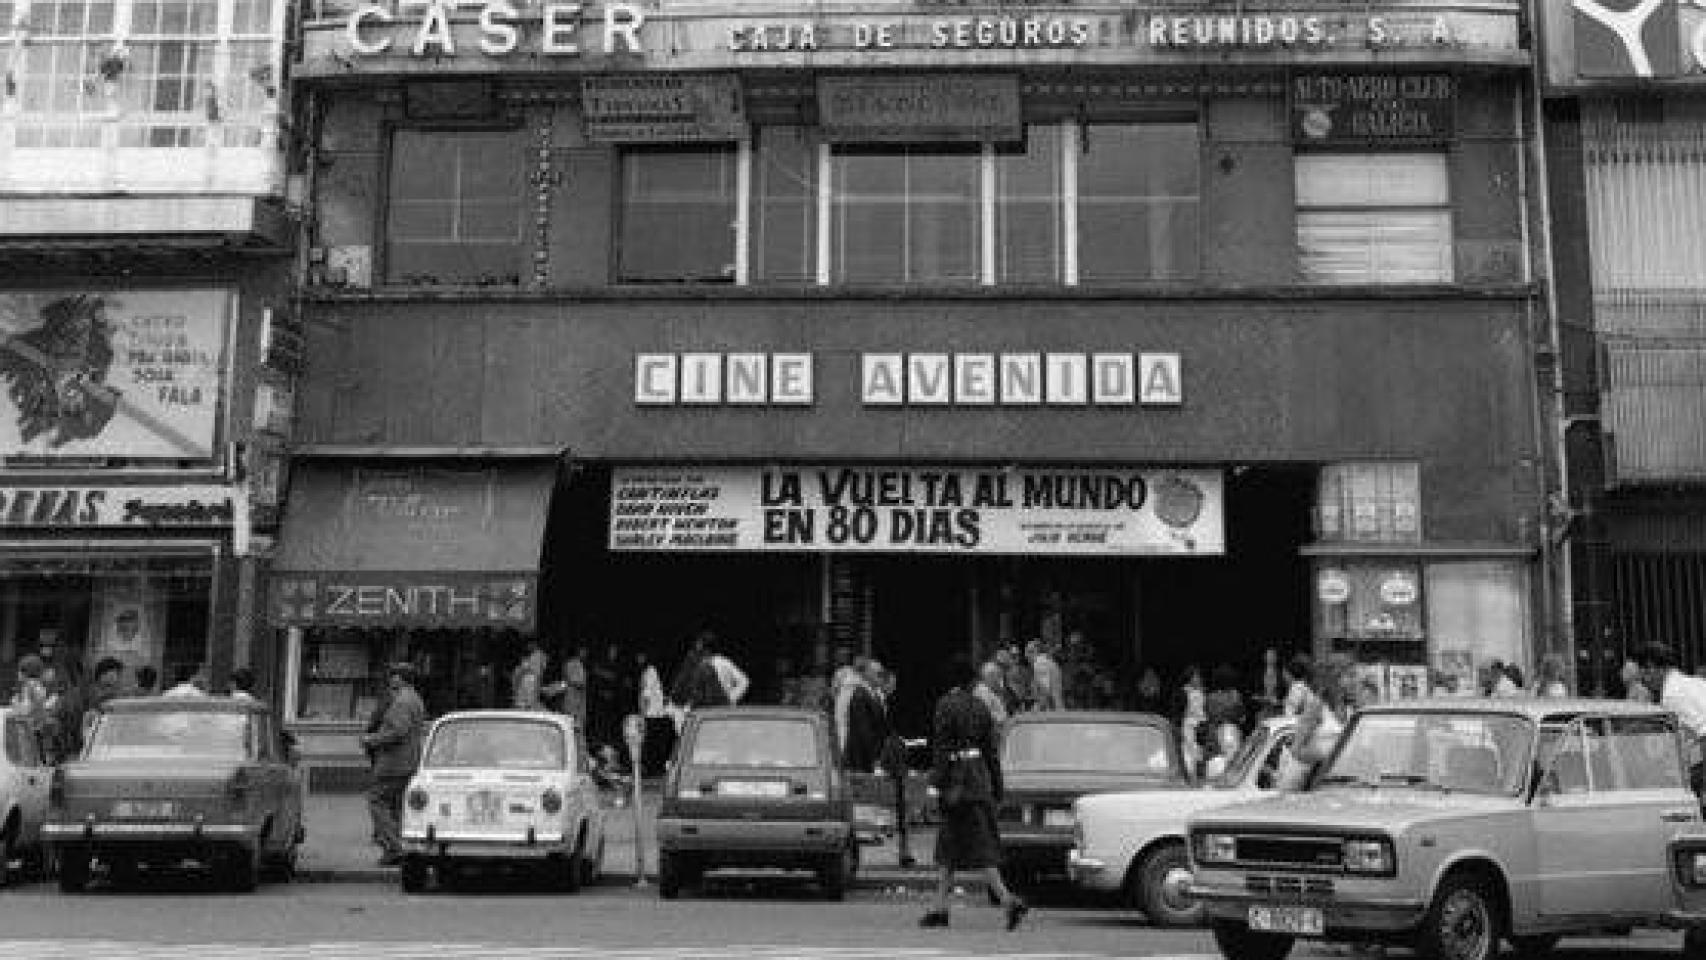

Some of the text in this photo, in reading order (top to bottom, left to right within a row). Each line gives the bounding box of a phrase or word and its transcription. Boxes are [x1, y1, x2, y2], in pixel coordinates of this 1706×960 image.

[346, 2, 644, 54] CASER
[729, 24, 817, 51] CAJA
[854, 23, 895, 48] DE
[932, 20, 1089, 48] SEGUROS
[637, 356, 1181, 400] CINE AVENIDA
[761, 468, 1147, 511] LA VUELTA AL MUNDO
[763, 505, 980, 549] EN 80 DIAS
[326, 584, 481, 616] ZENITH
